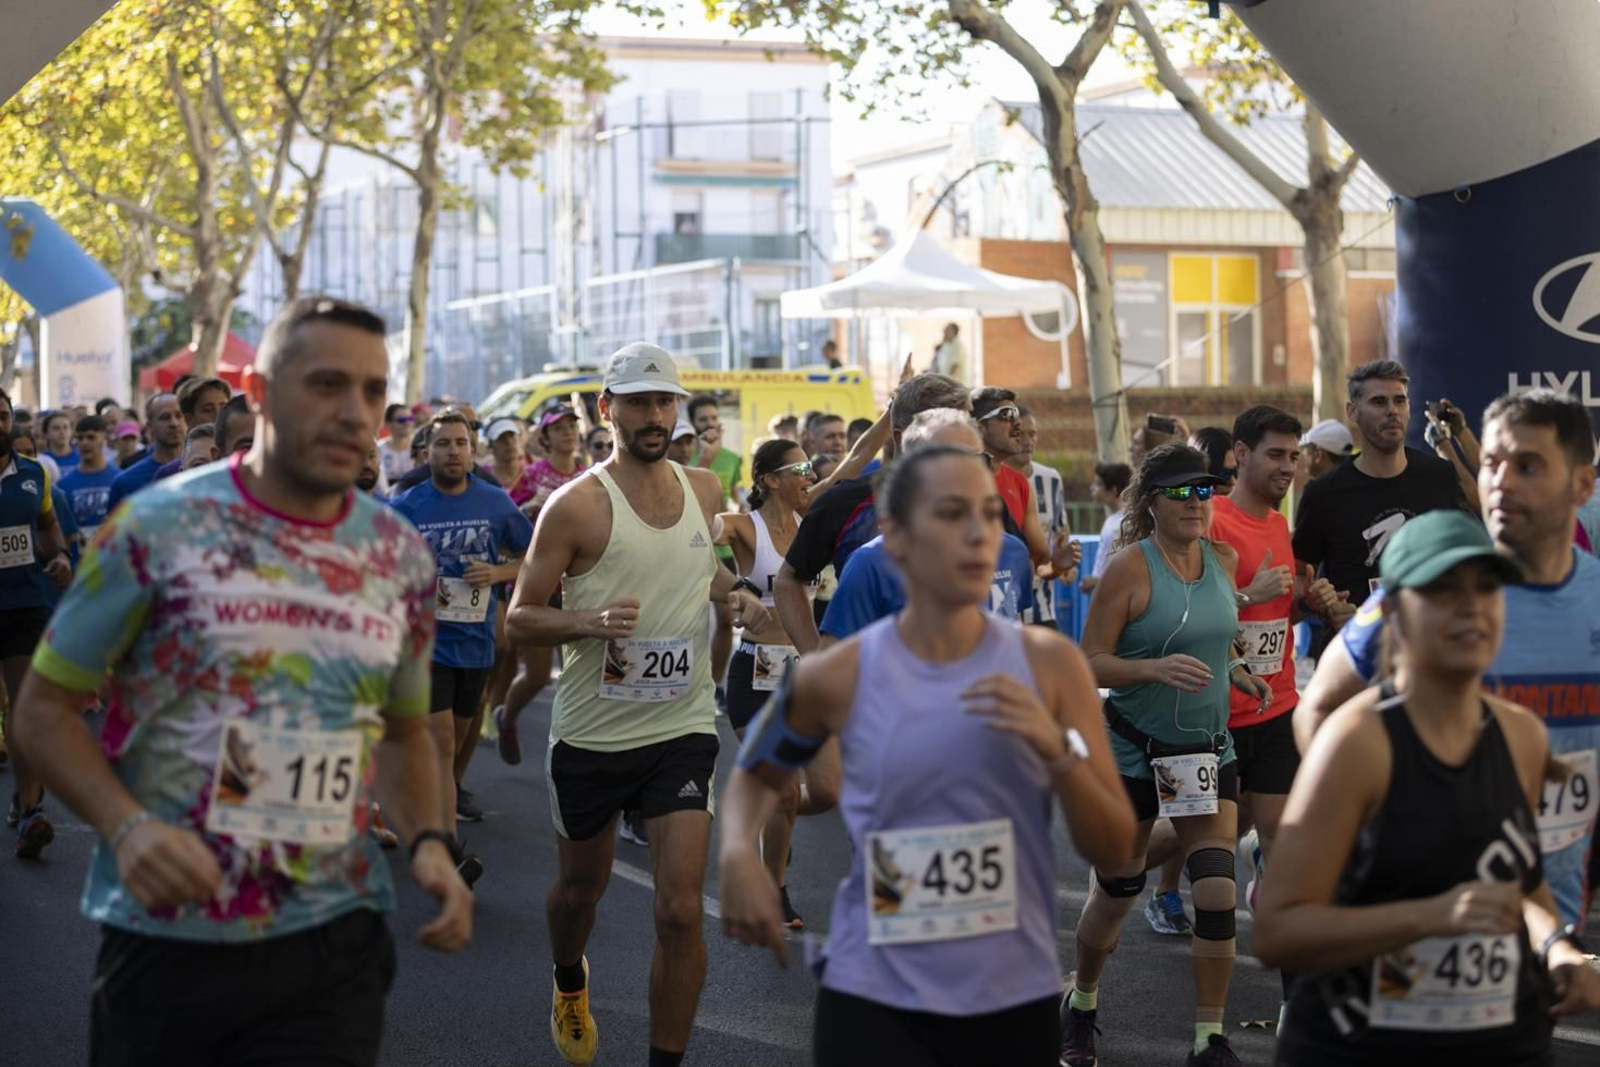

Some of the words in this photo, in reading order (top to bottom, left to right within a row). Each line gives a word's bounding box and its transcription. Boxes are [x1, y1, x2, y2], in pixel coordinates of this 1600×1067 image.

[681, 373, 805, 383] MBULANCIA
[1, 533, 28, 553] 509
[470, 588, 480, 607] 8
[215, 600, 354, 632] WOMEN'S
[1257, 630, 1286, 655] 297
[642, 649, 690, 678] 204
[286, 755, 352, 802] 115
[922, 845, 1003, 896] 435
[1434, 938, 1508, 988] 436
